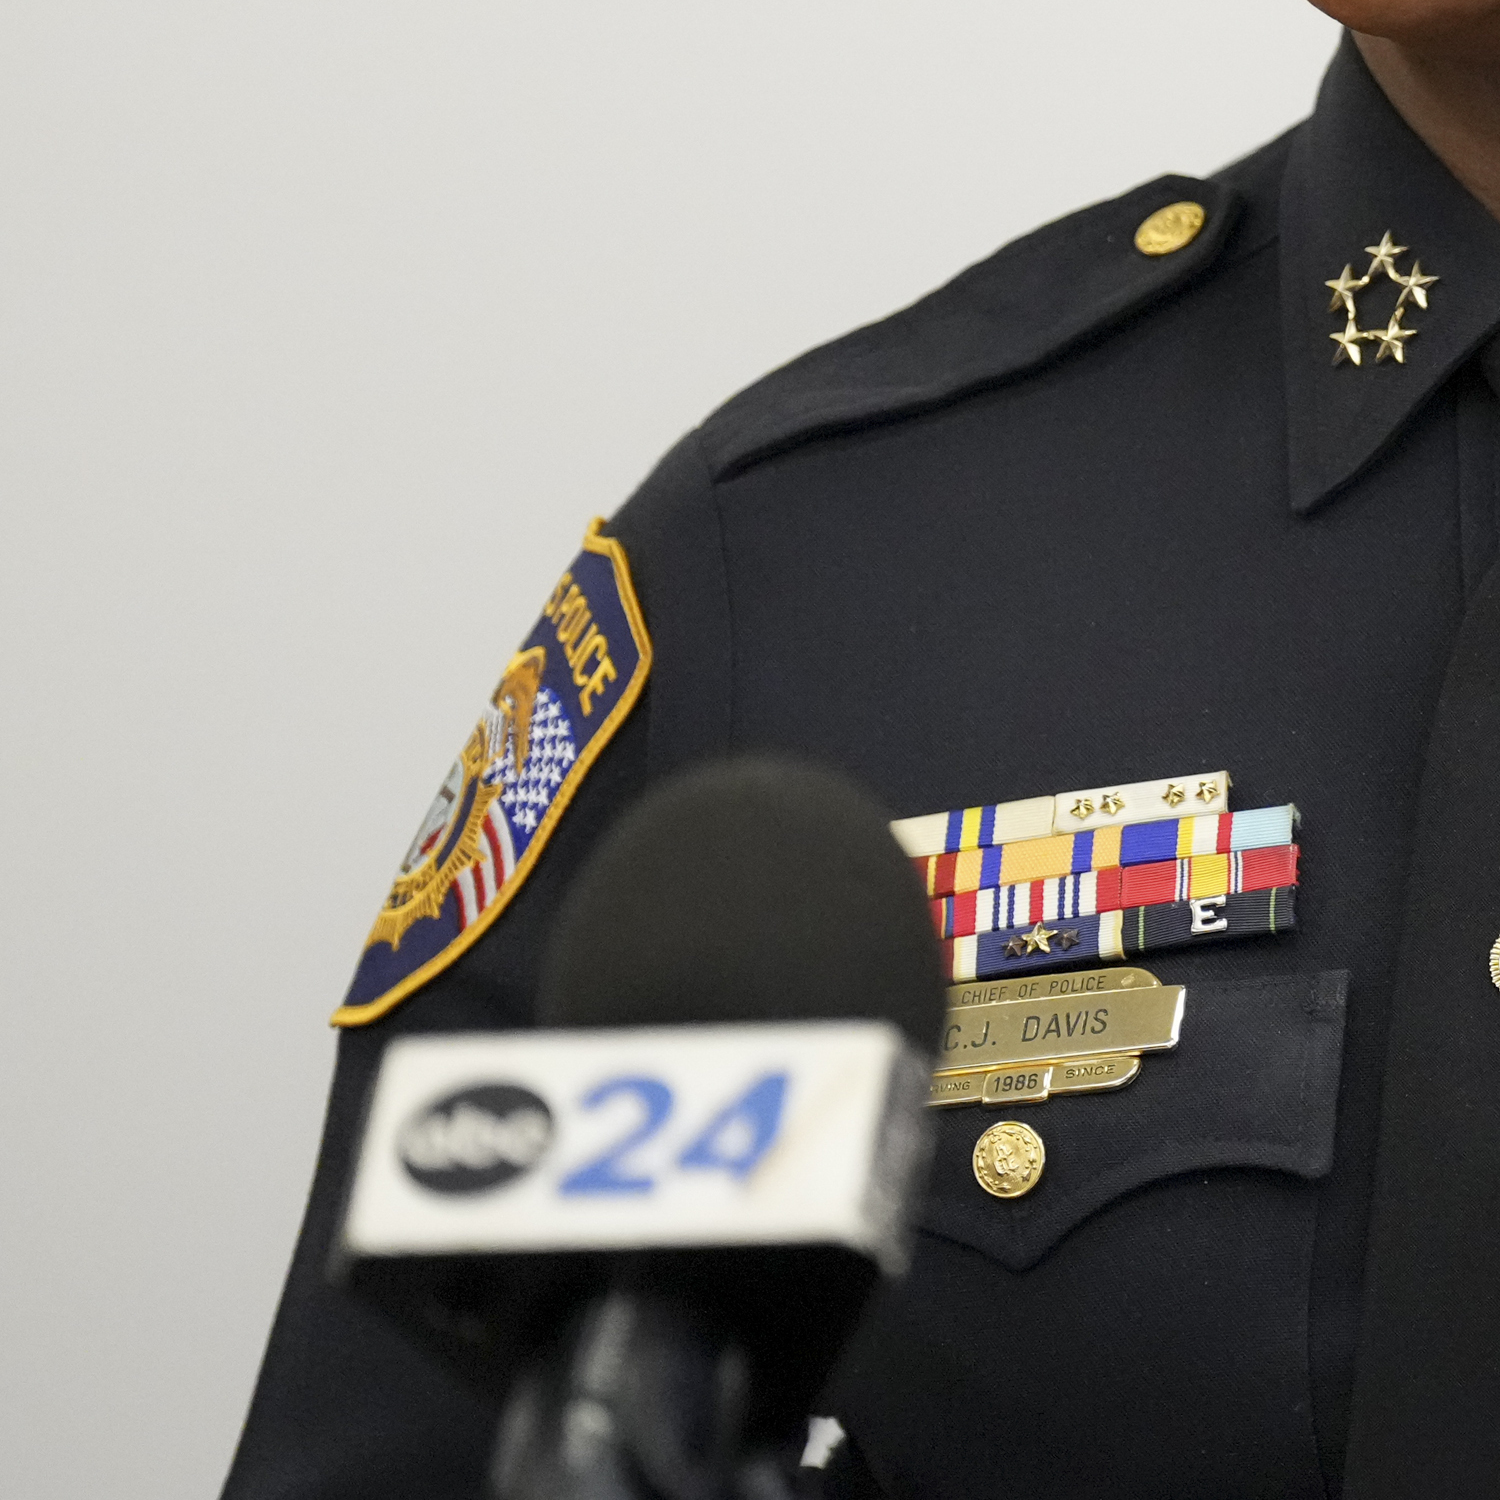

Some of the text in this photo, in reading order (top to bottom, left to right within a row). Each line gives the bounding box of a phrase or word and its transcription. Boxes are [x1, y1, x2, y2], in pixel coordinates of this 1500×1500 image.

[551, 583, 618, 718] POLICE
[1189, 893, 1229, 936] E
[961, 974, 1107, 1005] CHIEF OF POLICE
[944, 1007, 1109, 1051] C.J. DAVIS
[993, 1072, 1039, 1094] 1986
[1065, 1063, 1117, 1080] SINCE
[556, 1066, 794, 1199] 24
